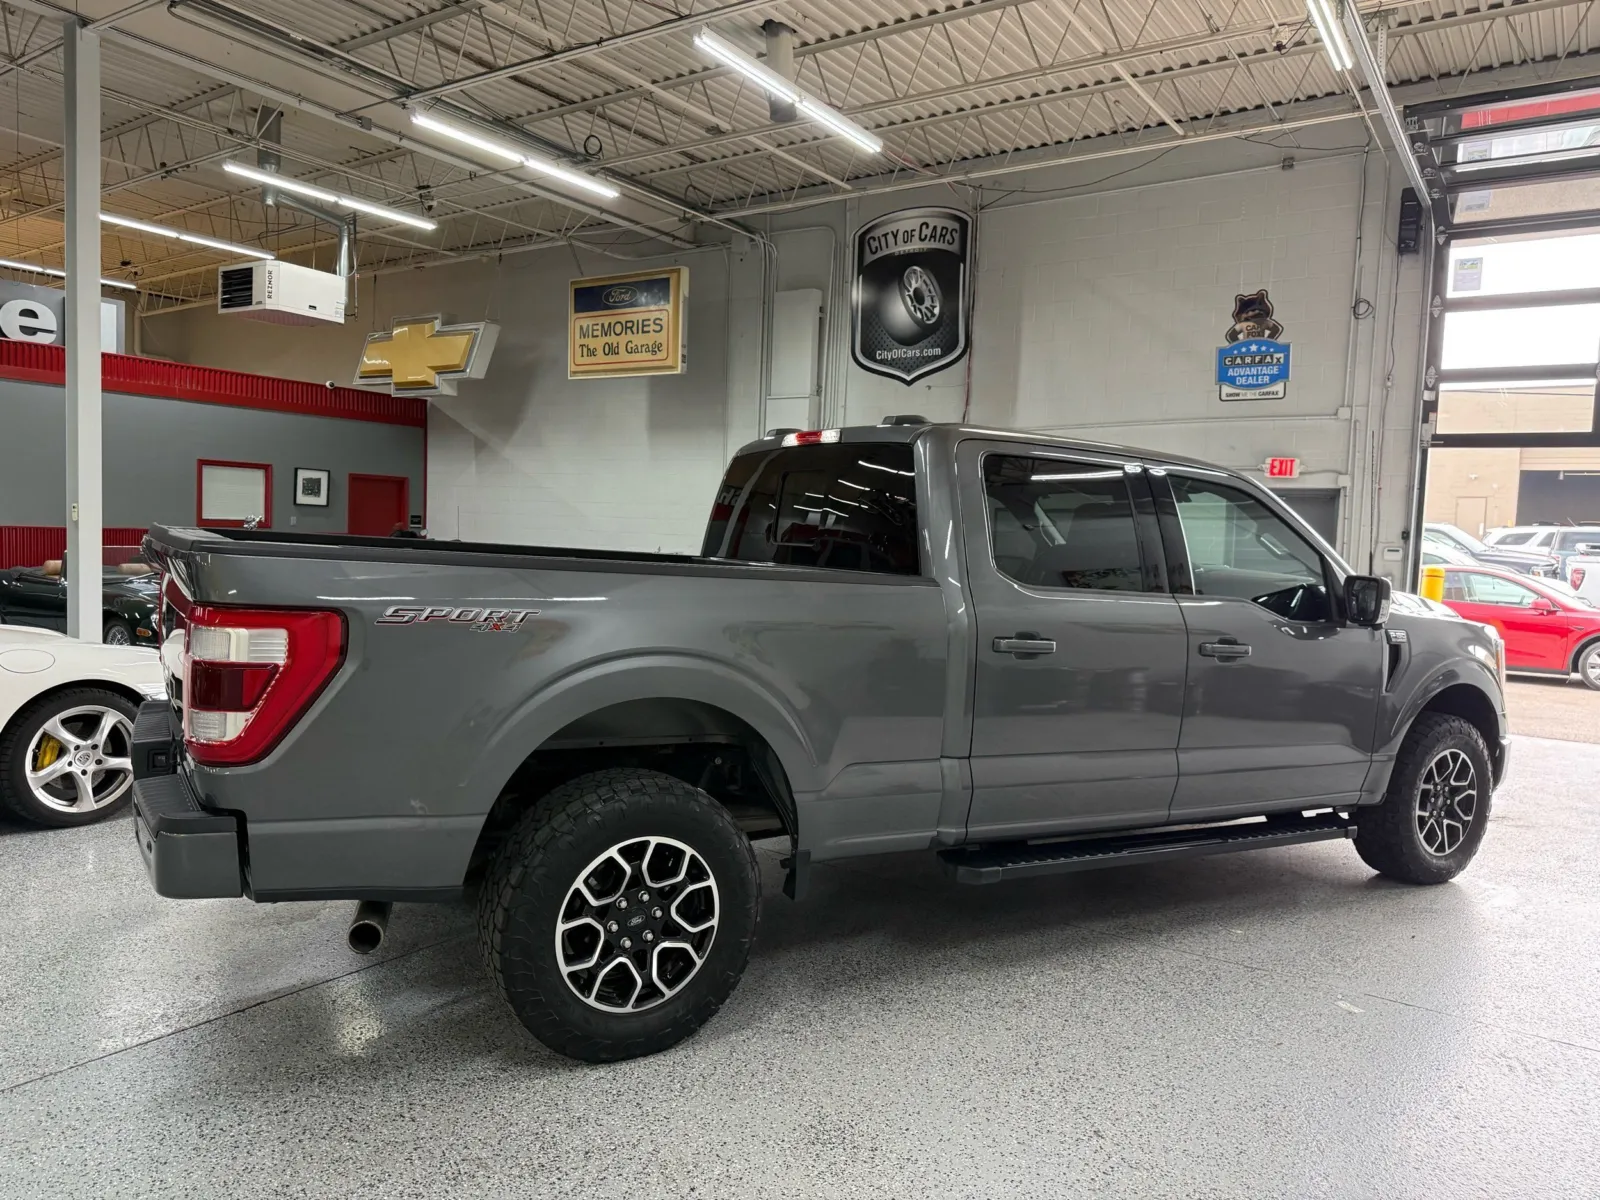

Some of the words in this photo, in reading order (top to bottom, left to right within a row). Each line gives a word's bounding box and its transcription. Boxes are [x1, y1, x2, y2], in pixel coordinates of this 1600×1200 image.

[866, 228, 900, 255] CITY
[902, 229, 917, 244] OF
[918, 221, 958, 246] CARS
[266, 269, 274, 299] REZNOR
[608, 288, 632, 303] Ford
[578, 317, 664, 339] MEMORIES
[578, 343, 598, 358] The
[602, 341, 620, 356] Old
[625, 340, 663, 356] Garage
[875, 347, 942, 361] CityOfCars.com
[1224, 354, 1283, 365] CARFAX
[1227, 366, 1280, 376] ADVANTAGE
[1236, 376, 1270, 385] DEALER
[1270, 458, 1295, 476] EXIT
[374, 605, 542, 625] SPORT
